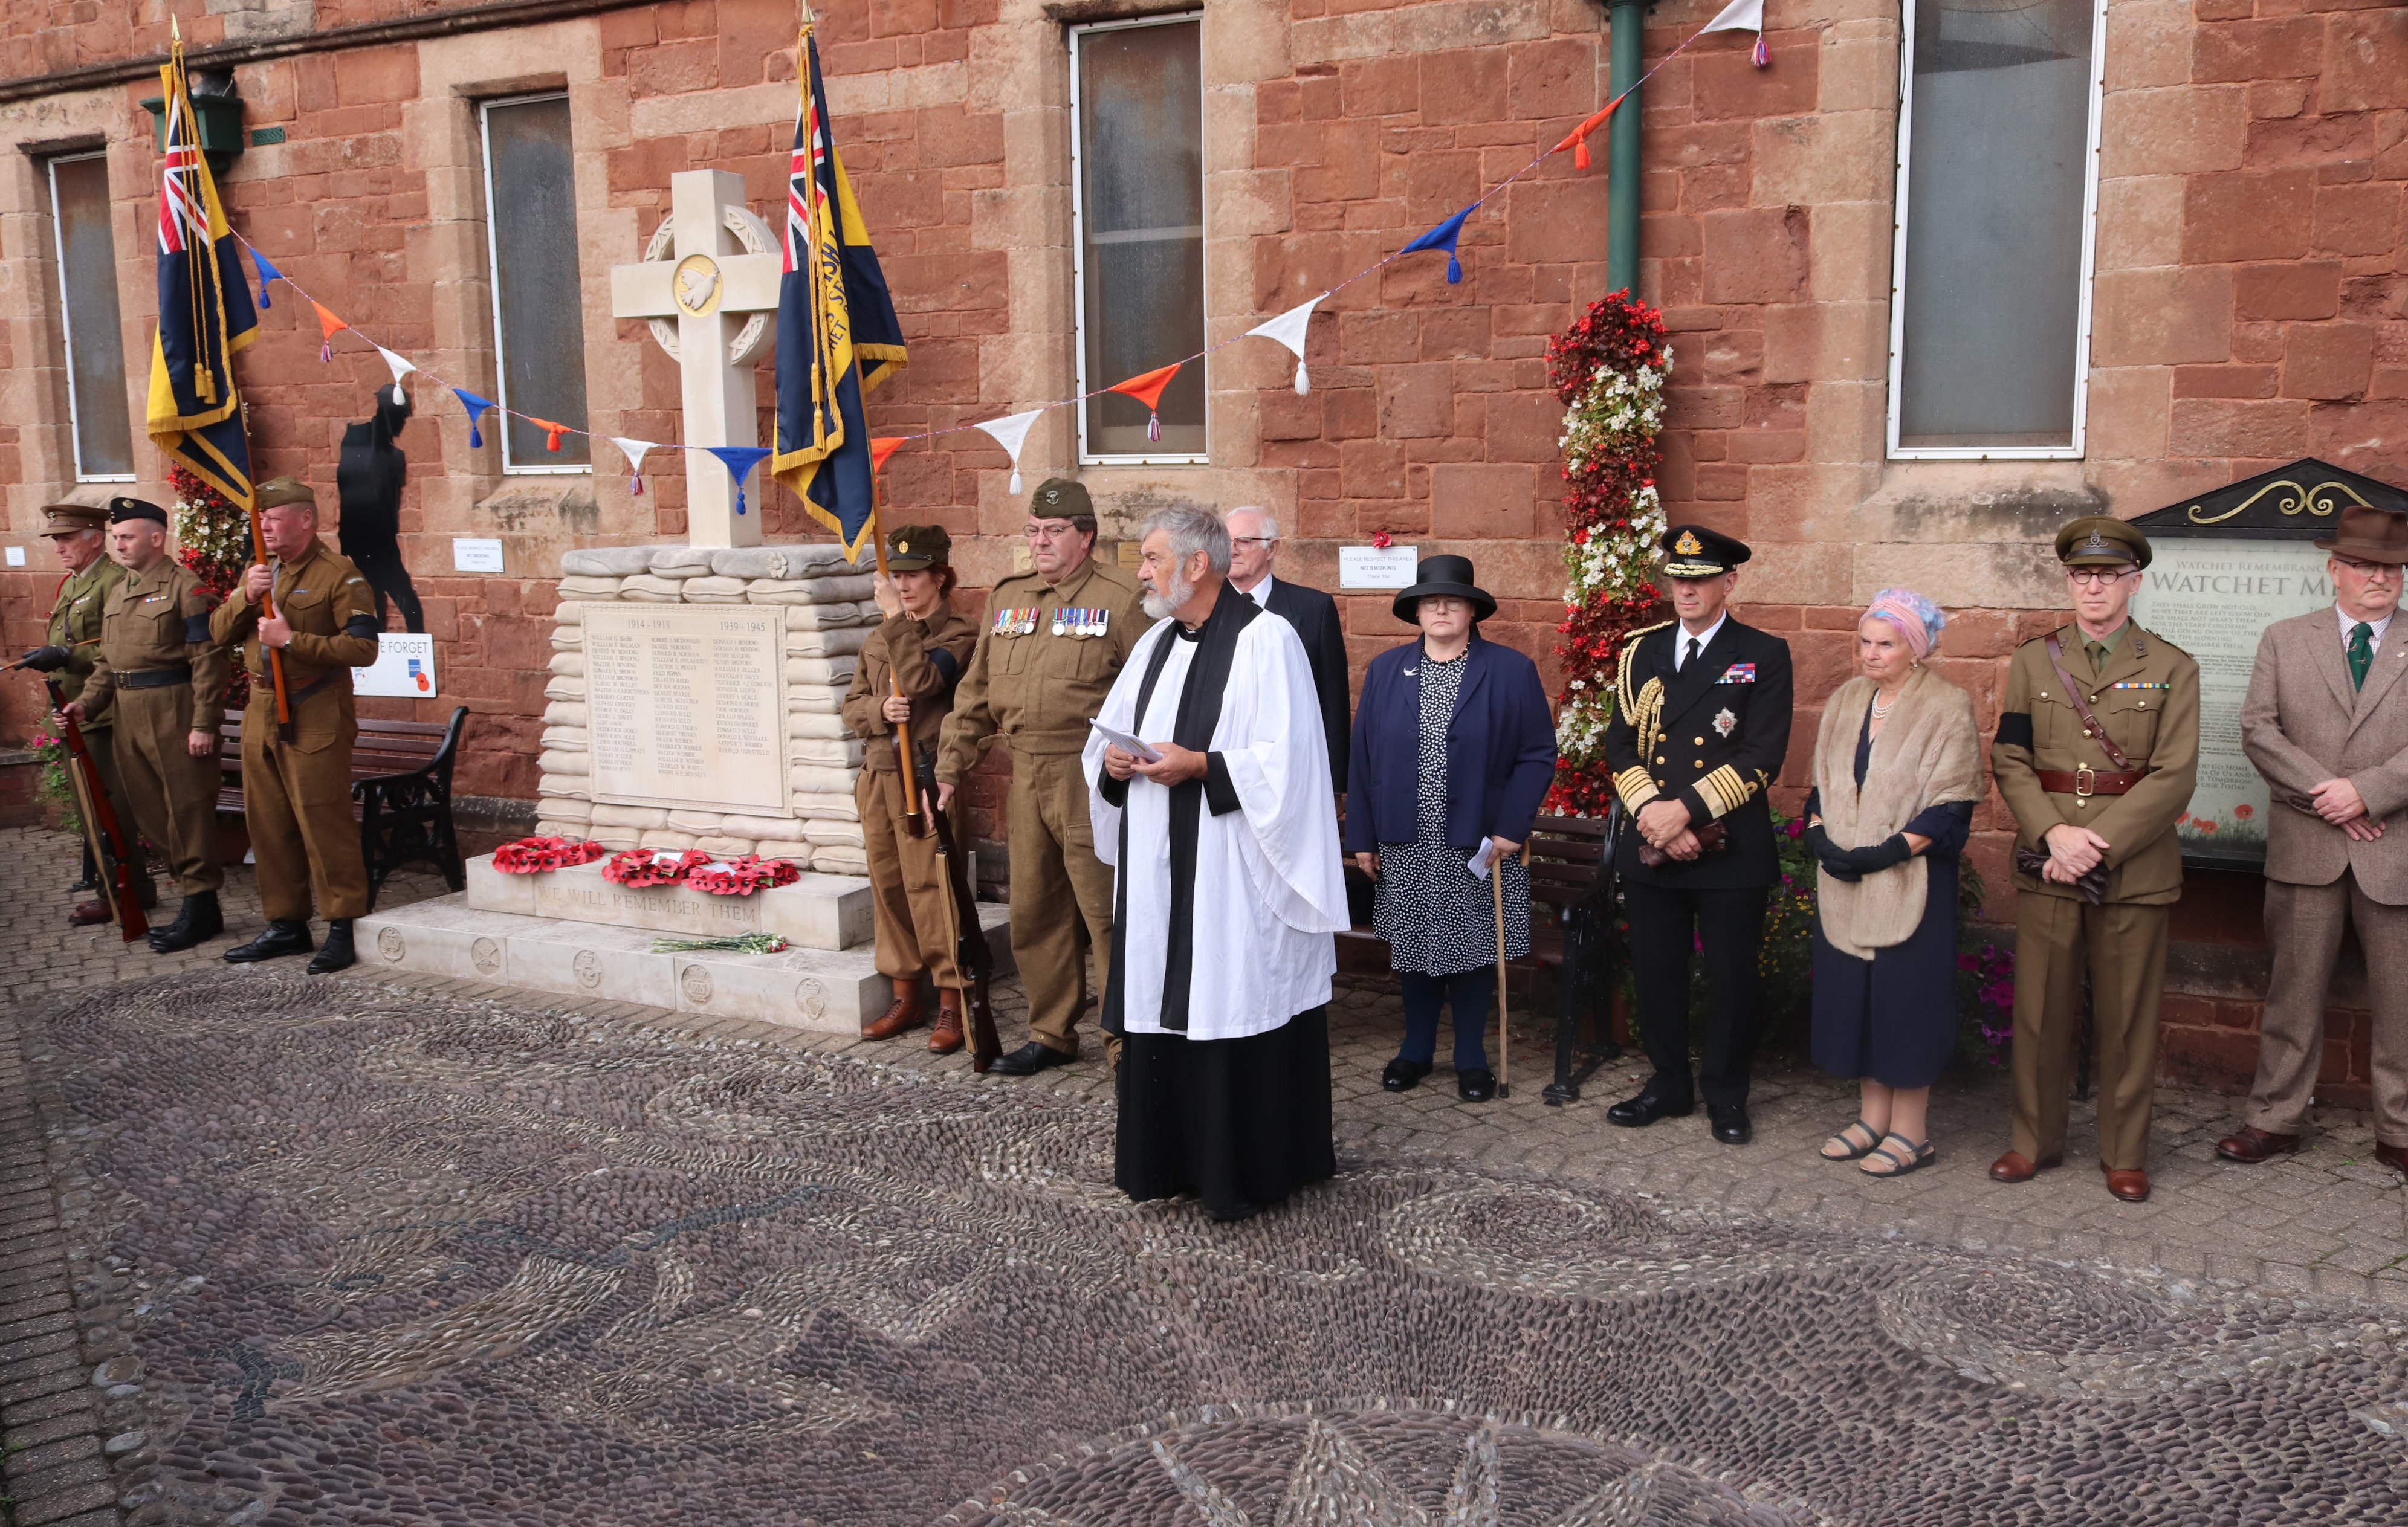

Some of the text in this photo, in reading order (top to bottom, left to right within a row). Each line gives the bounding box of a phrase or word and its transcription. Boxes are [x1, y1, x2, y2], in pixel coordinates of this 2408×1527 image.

[2176, 560, 2328, 573] WATCHET REMEMBRANC
[2151, 571, 2290, 595] WATCHET
[627, 619, 645, 628] 1914
[653, 620, 671, 629] 1918
[720, 621, 738, 631] 1939
[747, 622, 765, 632] 1945
[381, 642, 428, 653] E FORGET
[537, 885, 756, 922] WE WILL REMEMBER THEM
